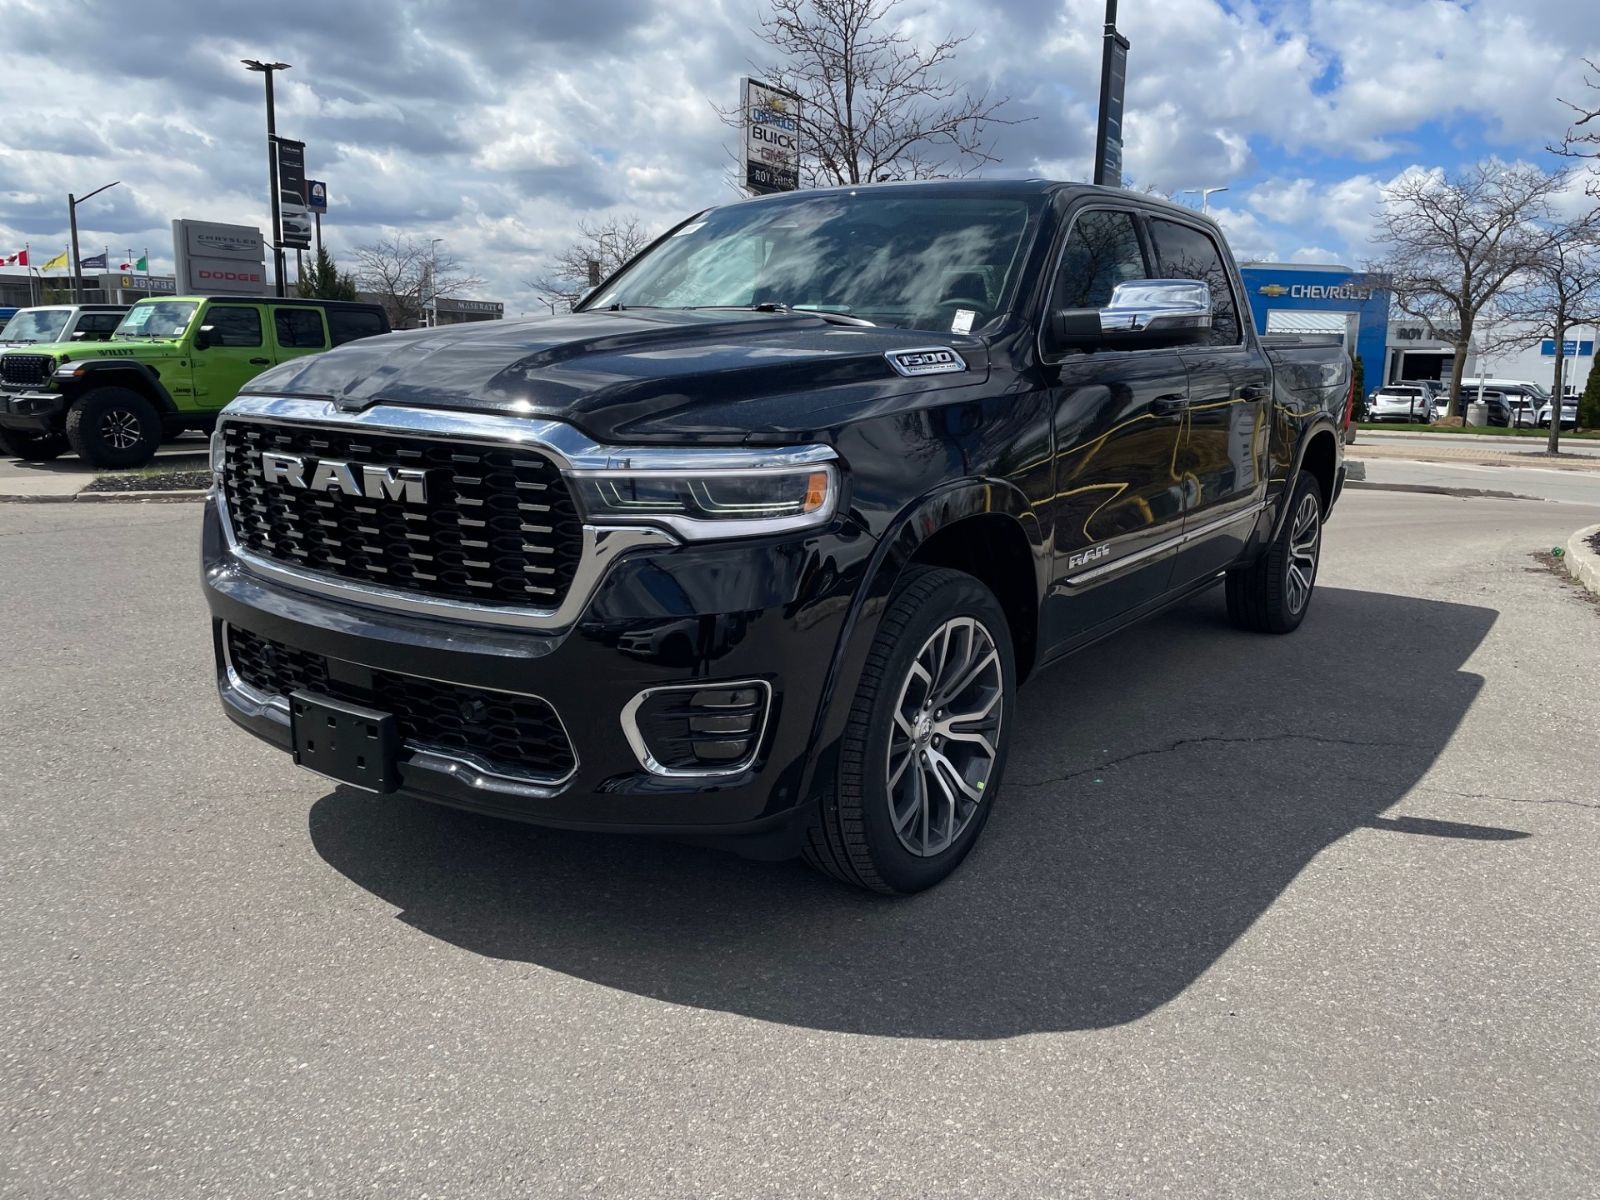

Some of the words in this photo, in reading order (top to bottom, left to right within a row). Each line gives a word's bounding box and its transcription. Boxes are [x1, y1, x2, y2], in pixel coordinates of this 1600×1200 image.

[752, 126, 796, 151] BUICK
[755, 169, 771, 183] ROY
[198, 235, 256, 244] CHRYSLER
[133, 277, 176, 289] Ferrar
[199, 271, 260, 281] DODGE
[1291, 285, 1373, 300] CHEVROLET
[457, 302, 497, 311] MASERATI
[1397, 327, 1424, 340] ROY
[898, 352, 952, 366] 1500
[262, 452, 428, 504] RAM
[1069, 543, 1110, 569] RAM
